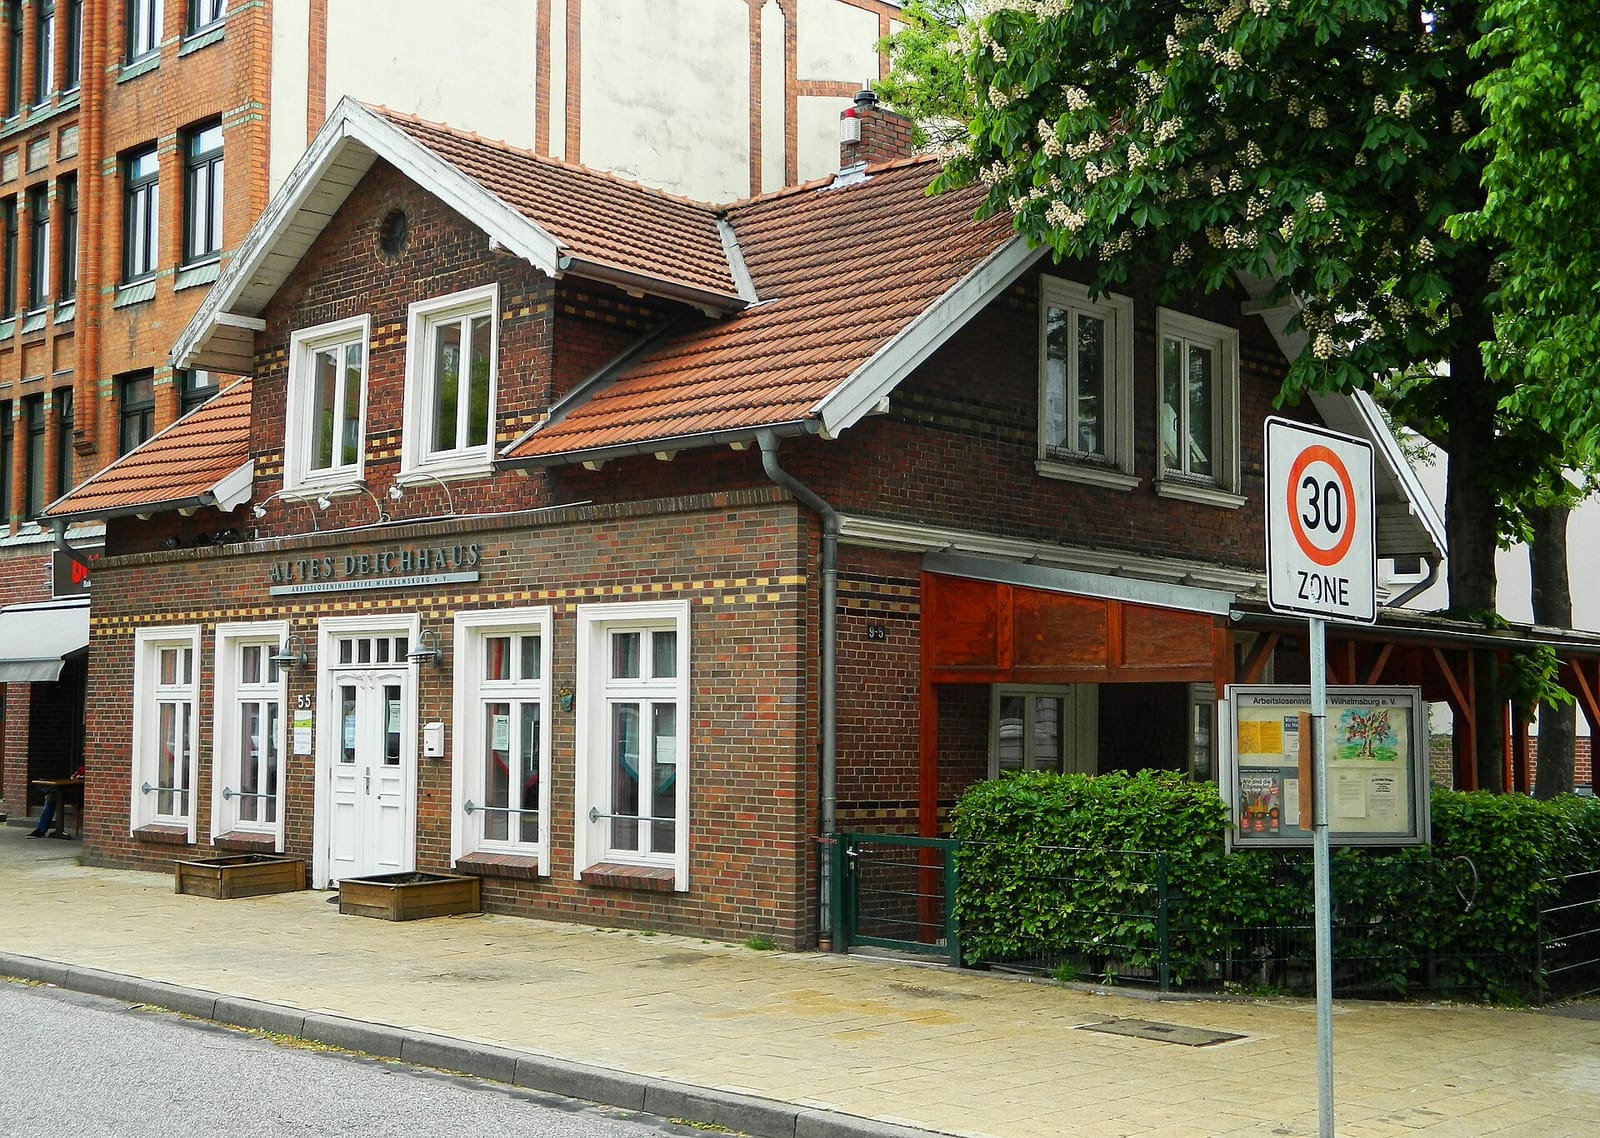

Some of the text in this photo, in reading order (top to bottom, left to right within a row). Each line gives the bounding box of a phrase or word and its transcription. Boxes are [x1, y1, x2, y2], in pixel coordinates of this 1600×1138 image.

[1302, 476, 1341, 534] 30
[271, 543, 480, 582] ALTES DEICHHAUS
[1298, 570, 1349, 606] ZONE
[298, 693, 311, 709] 55
[1331, 697, 1380, 706] Wilhelmsburg
